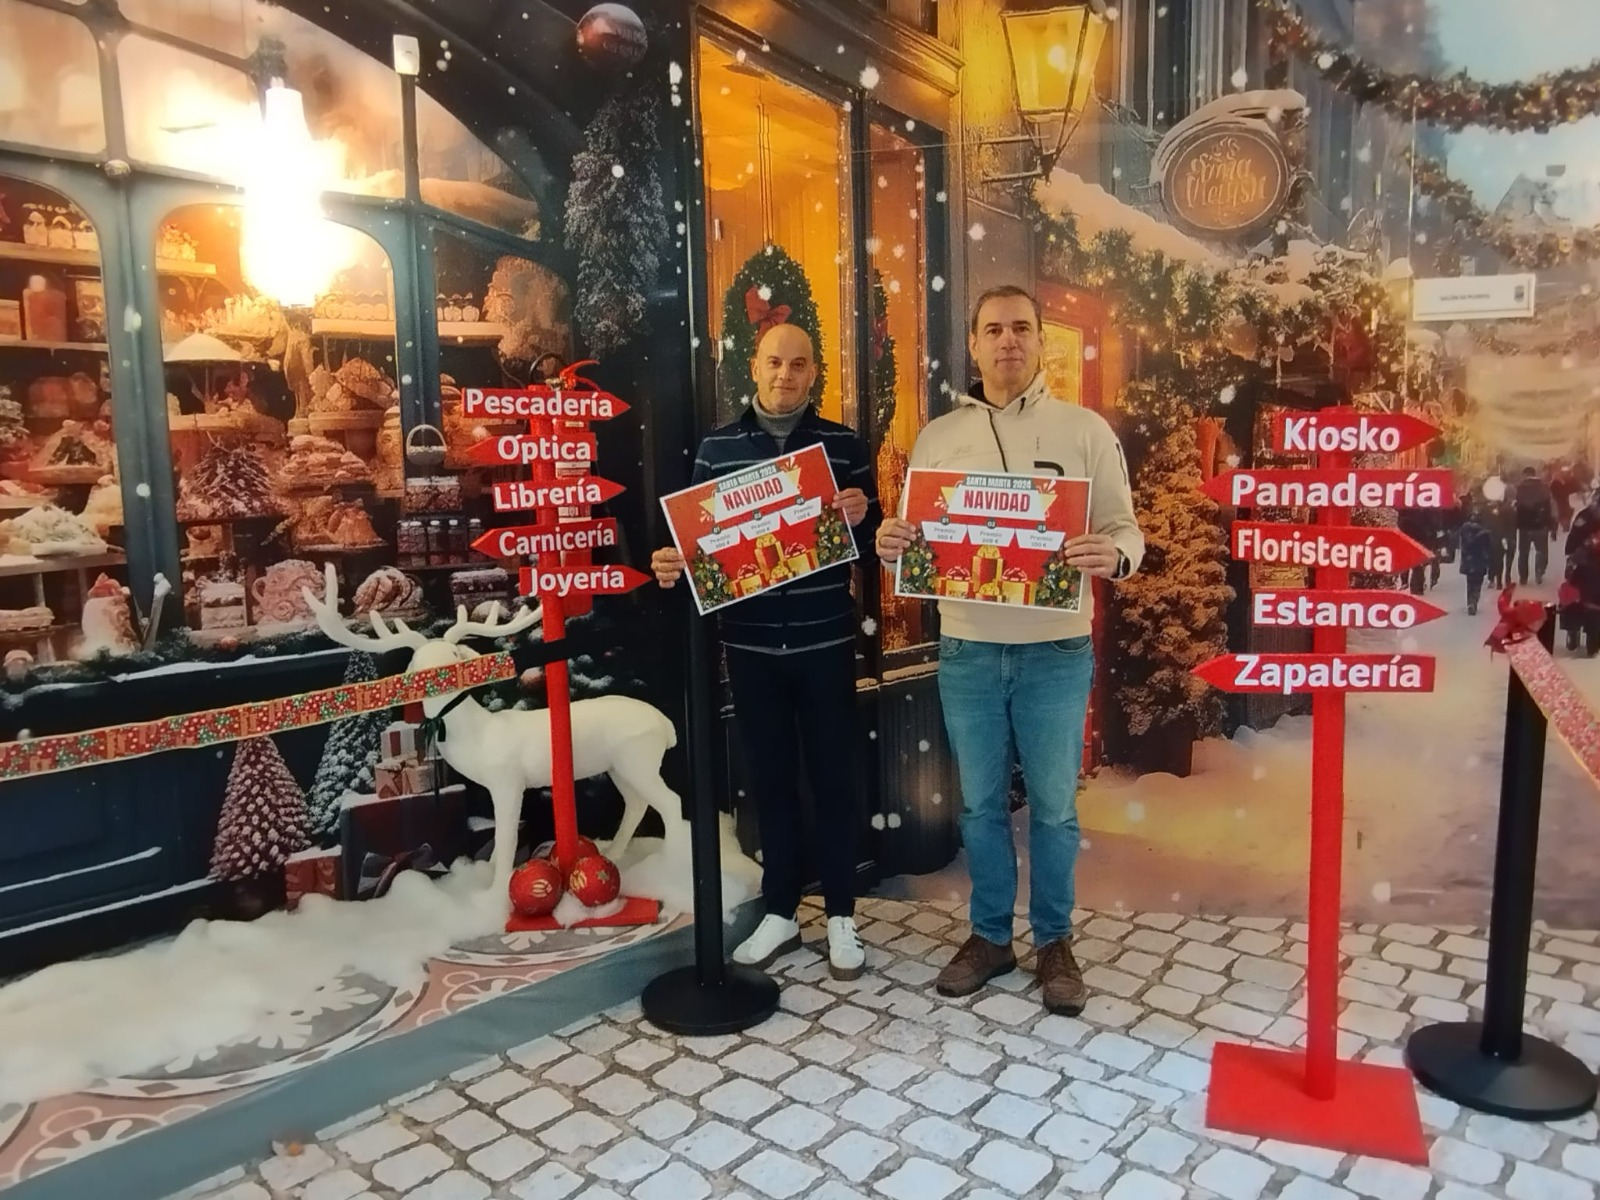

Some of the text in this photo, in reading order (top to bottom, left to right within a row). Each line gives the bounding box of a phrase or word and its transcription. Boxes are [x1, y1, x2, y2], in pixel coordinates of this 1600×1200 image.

[466, 388, 613, 417] Pescadería
[498, 434, 591, 464] Óptica
[1283, 416, 1400, 451] Kiosko
[494, 478, 602, 510] Librería
[718, 478, 738, 490] SANTA
[738, 472, 760, 484] MARTA
[722, 478, 783, 511] NAVIDAD
[966, 476, 1032, 489] SANTA MARTA 2024
[1232, 472, 1441, 507] Panadería
[963, 490, 1031, 513] NAVIDAD
[499, 523, 615, 557] Carnicería
[1237, 529, 1393, 573] Floristería
[529, 565, 625, 597] Joyería
[1253, 593, 1416, 628] Estanco
[1234, 655, 1421, 695] Zapatería
